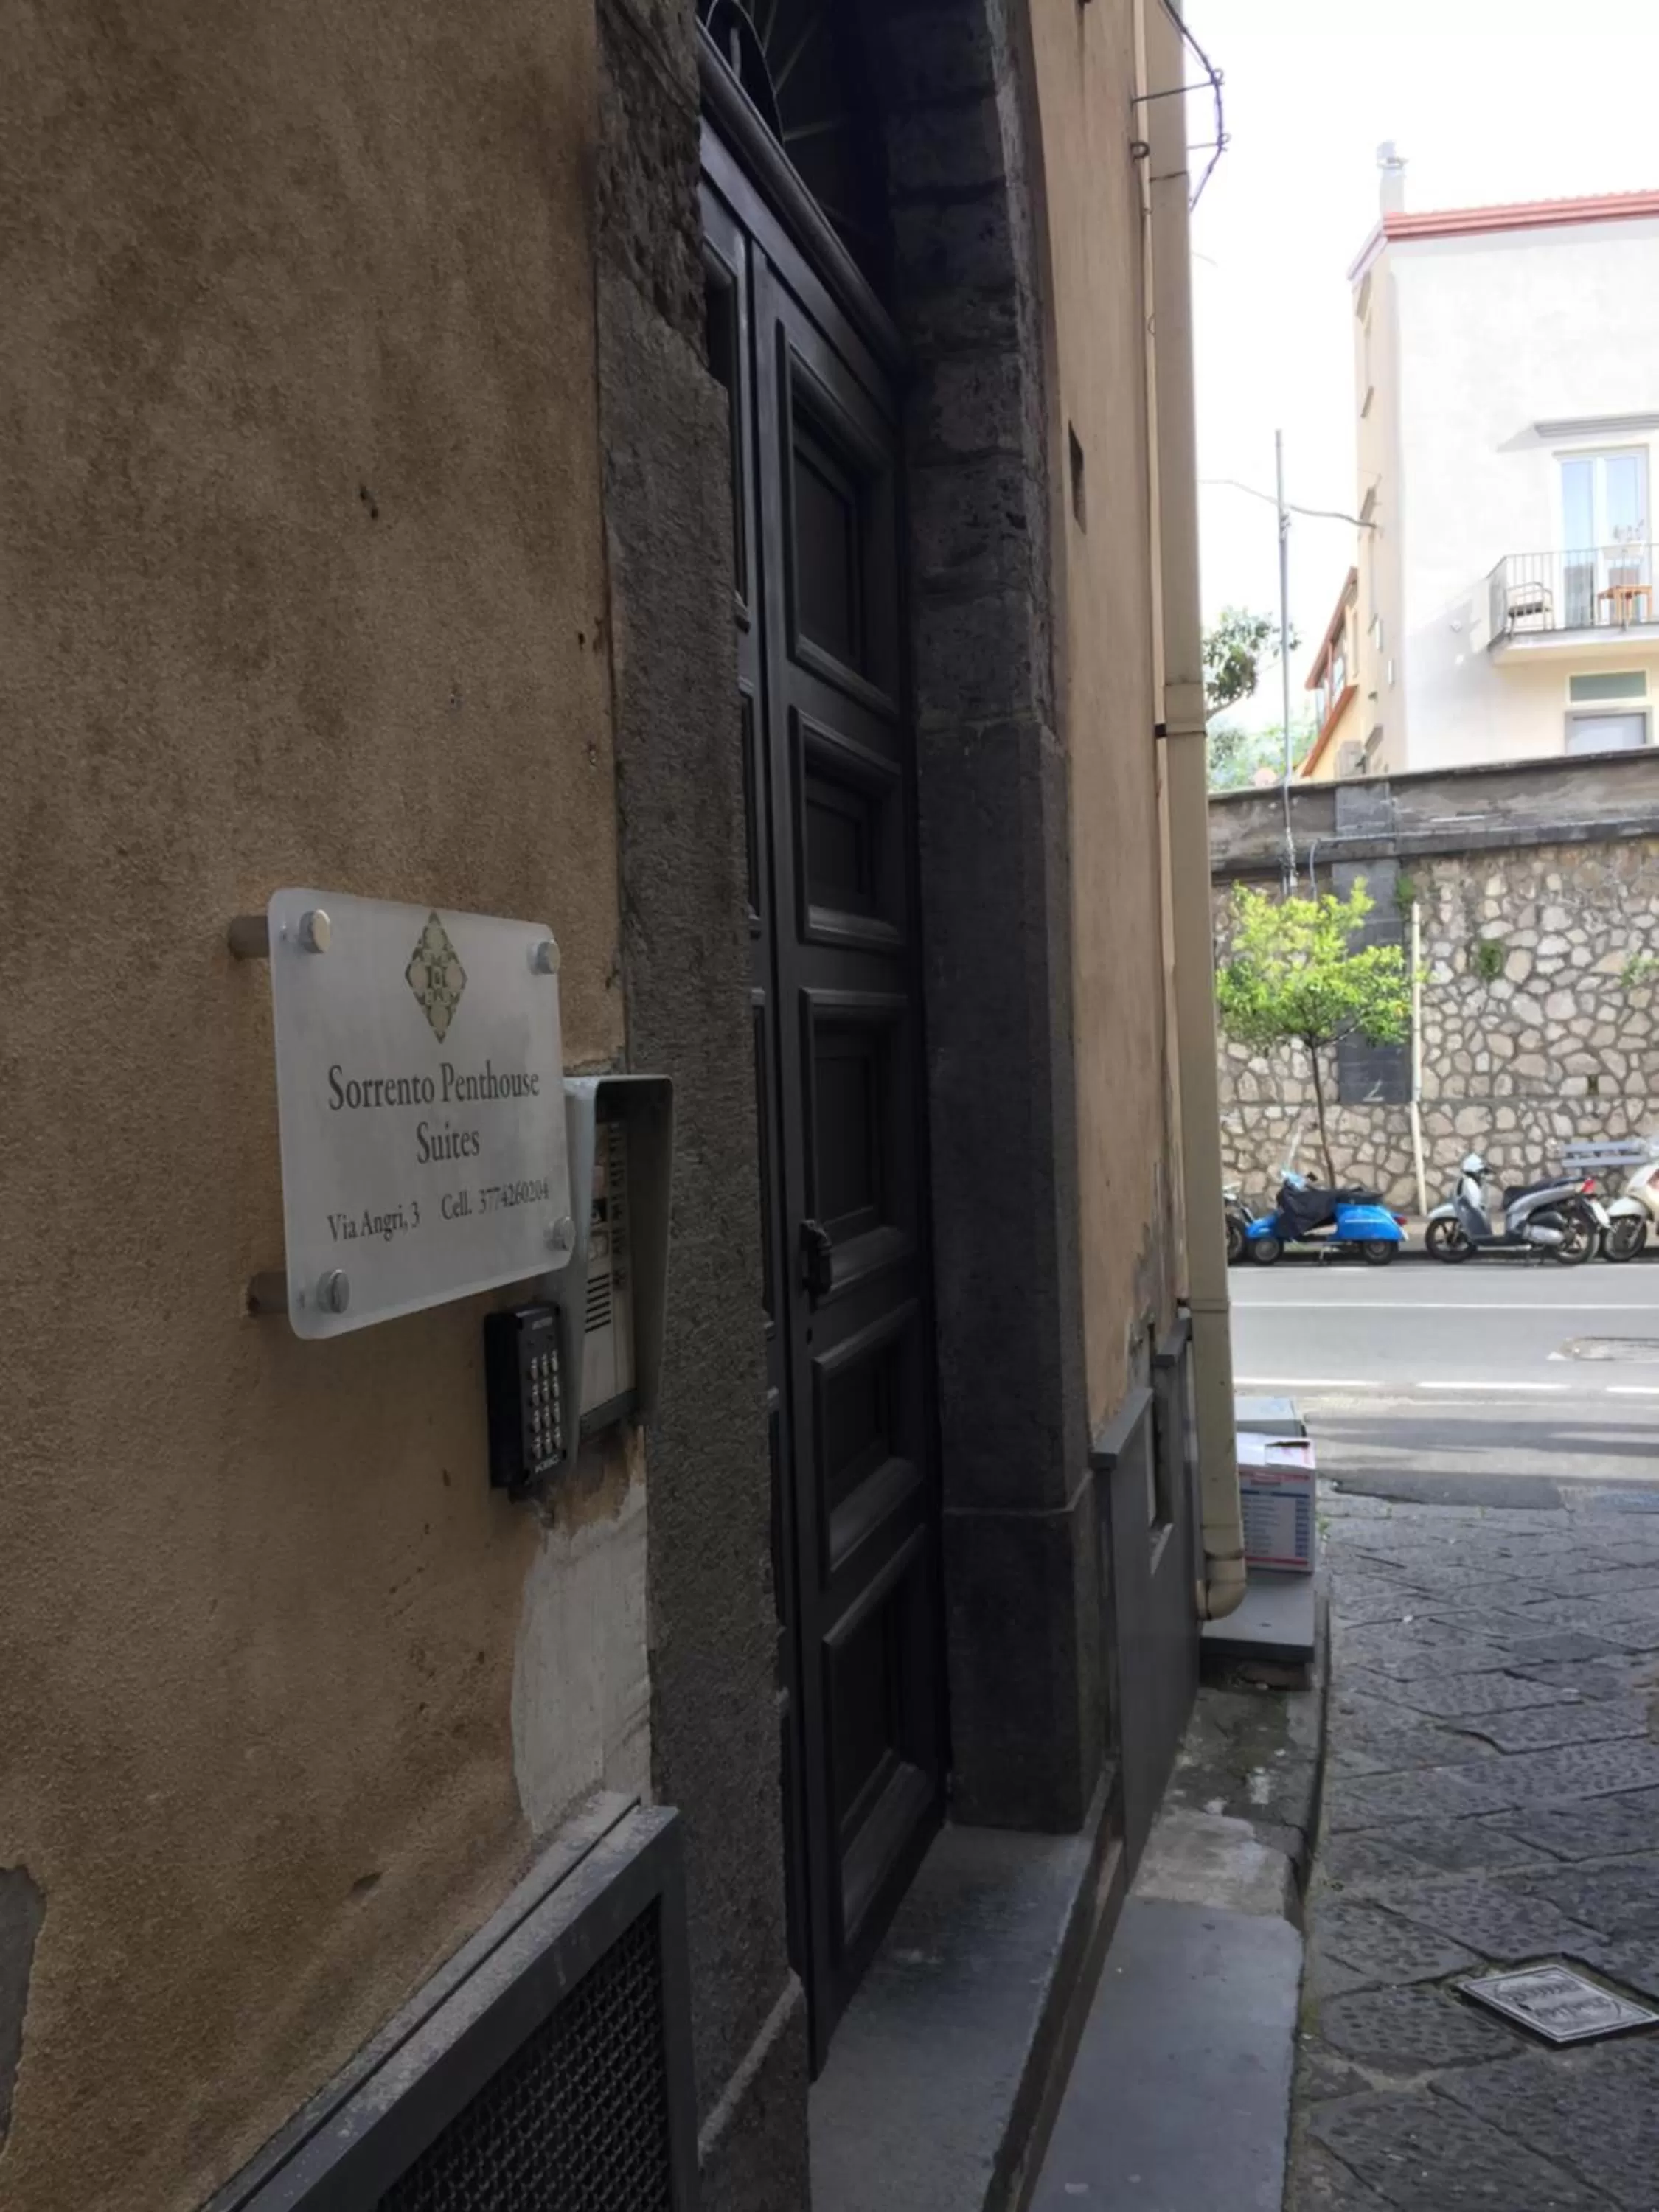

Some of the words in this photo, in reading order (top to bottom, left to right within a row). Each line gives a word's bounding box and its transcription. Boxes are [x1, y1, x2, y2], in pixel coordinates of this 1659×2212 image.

[328, 1064, 434, 1110] Sorrento
[439, 1060, 540, 1102] Penthouse
[416, 1121, 480, 1164] Suites
[327, 1214, 358, 1242] Via
[361, 1204, 408, 1242] Angri,
[411, 1201, 420, 1228] 3
[440, 1191, 473, 1220] Cell.
